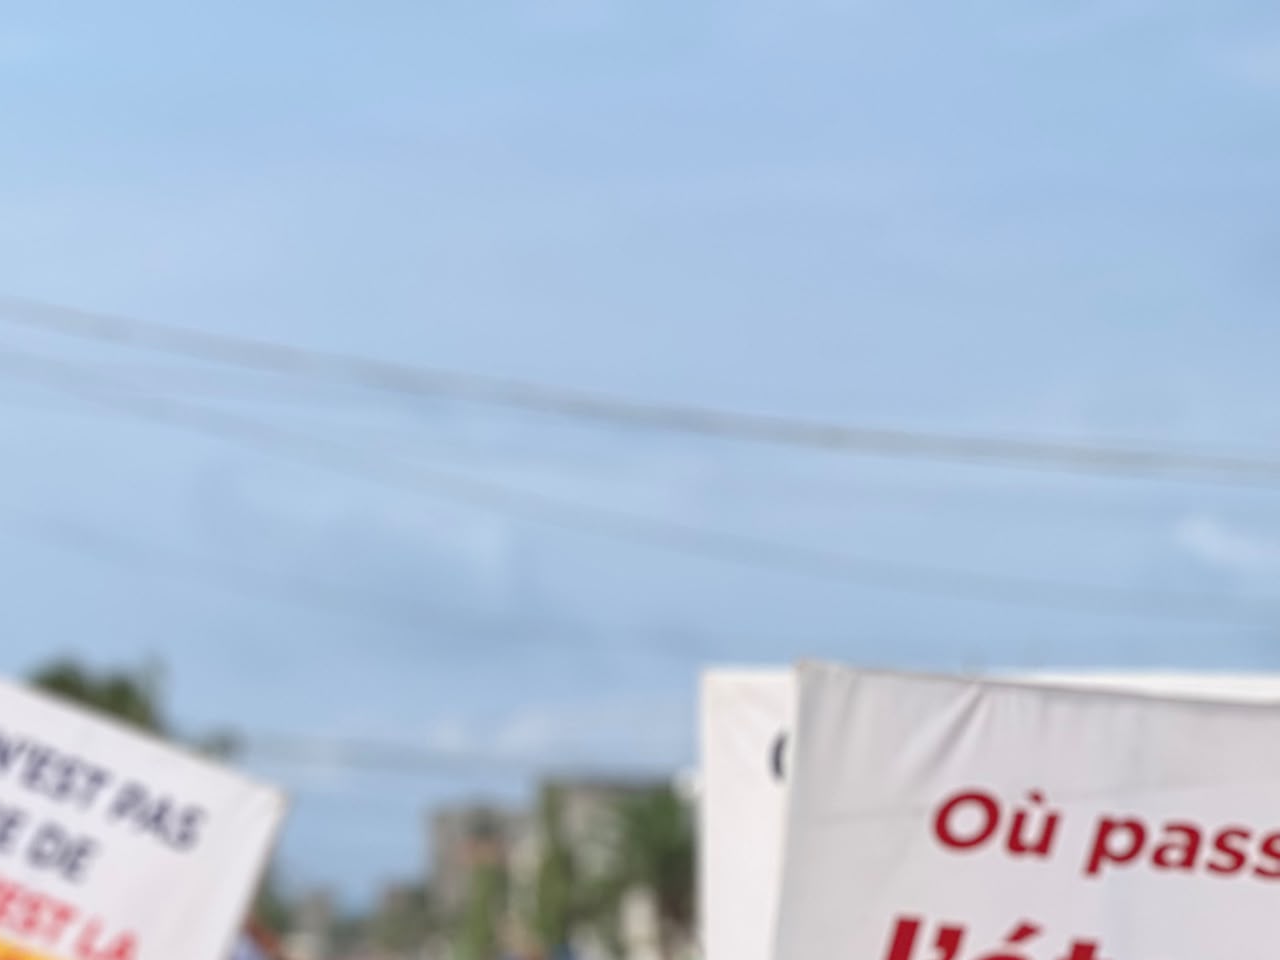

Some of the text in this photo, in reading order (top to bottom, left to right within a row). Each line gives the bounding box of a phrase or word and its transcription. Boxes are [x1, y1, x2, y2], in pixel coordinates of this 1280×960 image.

[109, 783, 204, 851] PAS
[933, 790, 1060, 857] Où
[28, 823, 96, 882] DE
